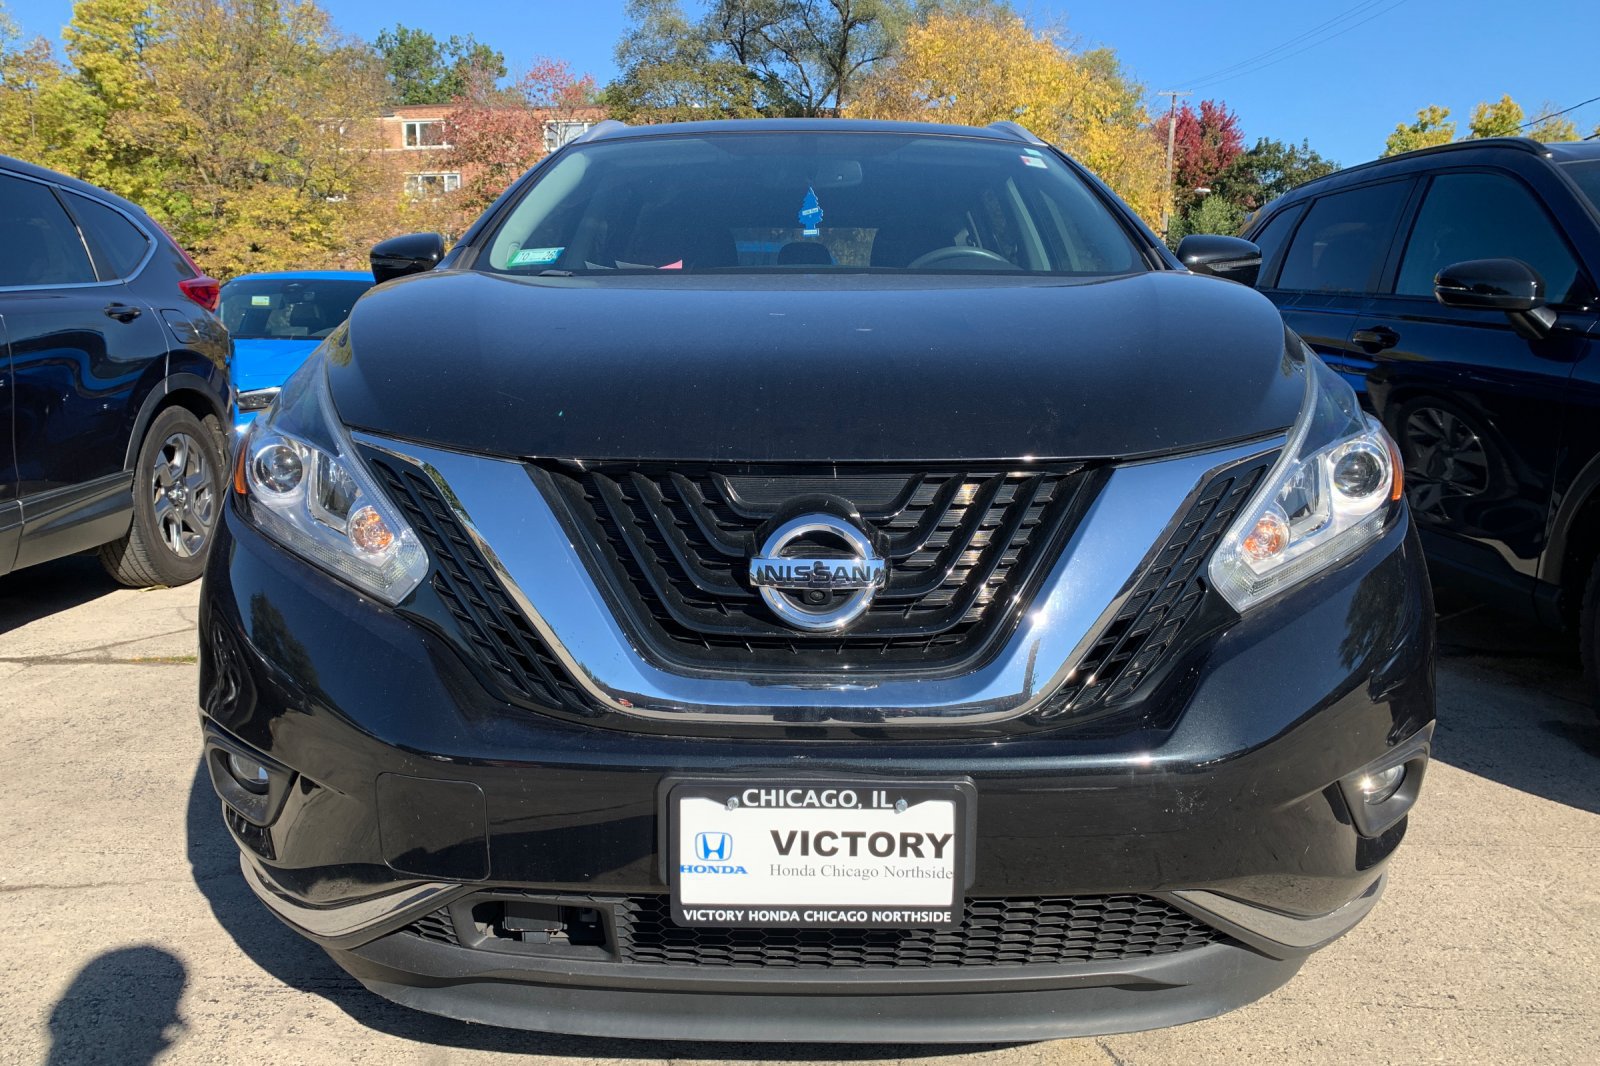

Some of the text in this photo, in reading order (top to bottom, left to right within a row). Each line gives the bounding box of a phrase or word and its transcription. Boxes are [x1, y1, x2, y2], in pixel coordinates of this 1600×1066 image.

[764, 564, 871, 582] NISSAN
[742, 788, 894, 810] CHICAGO, IL
[770, 830, 954, 859] VICTORY
[680, 864, 748, 874] HONDA
[770, 863, 954, 881] Honda Chicago Northside
[683, 909, 952, 923] VICTORY HONDA CHICAGO NORTHSIDE
